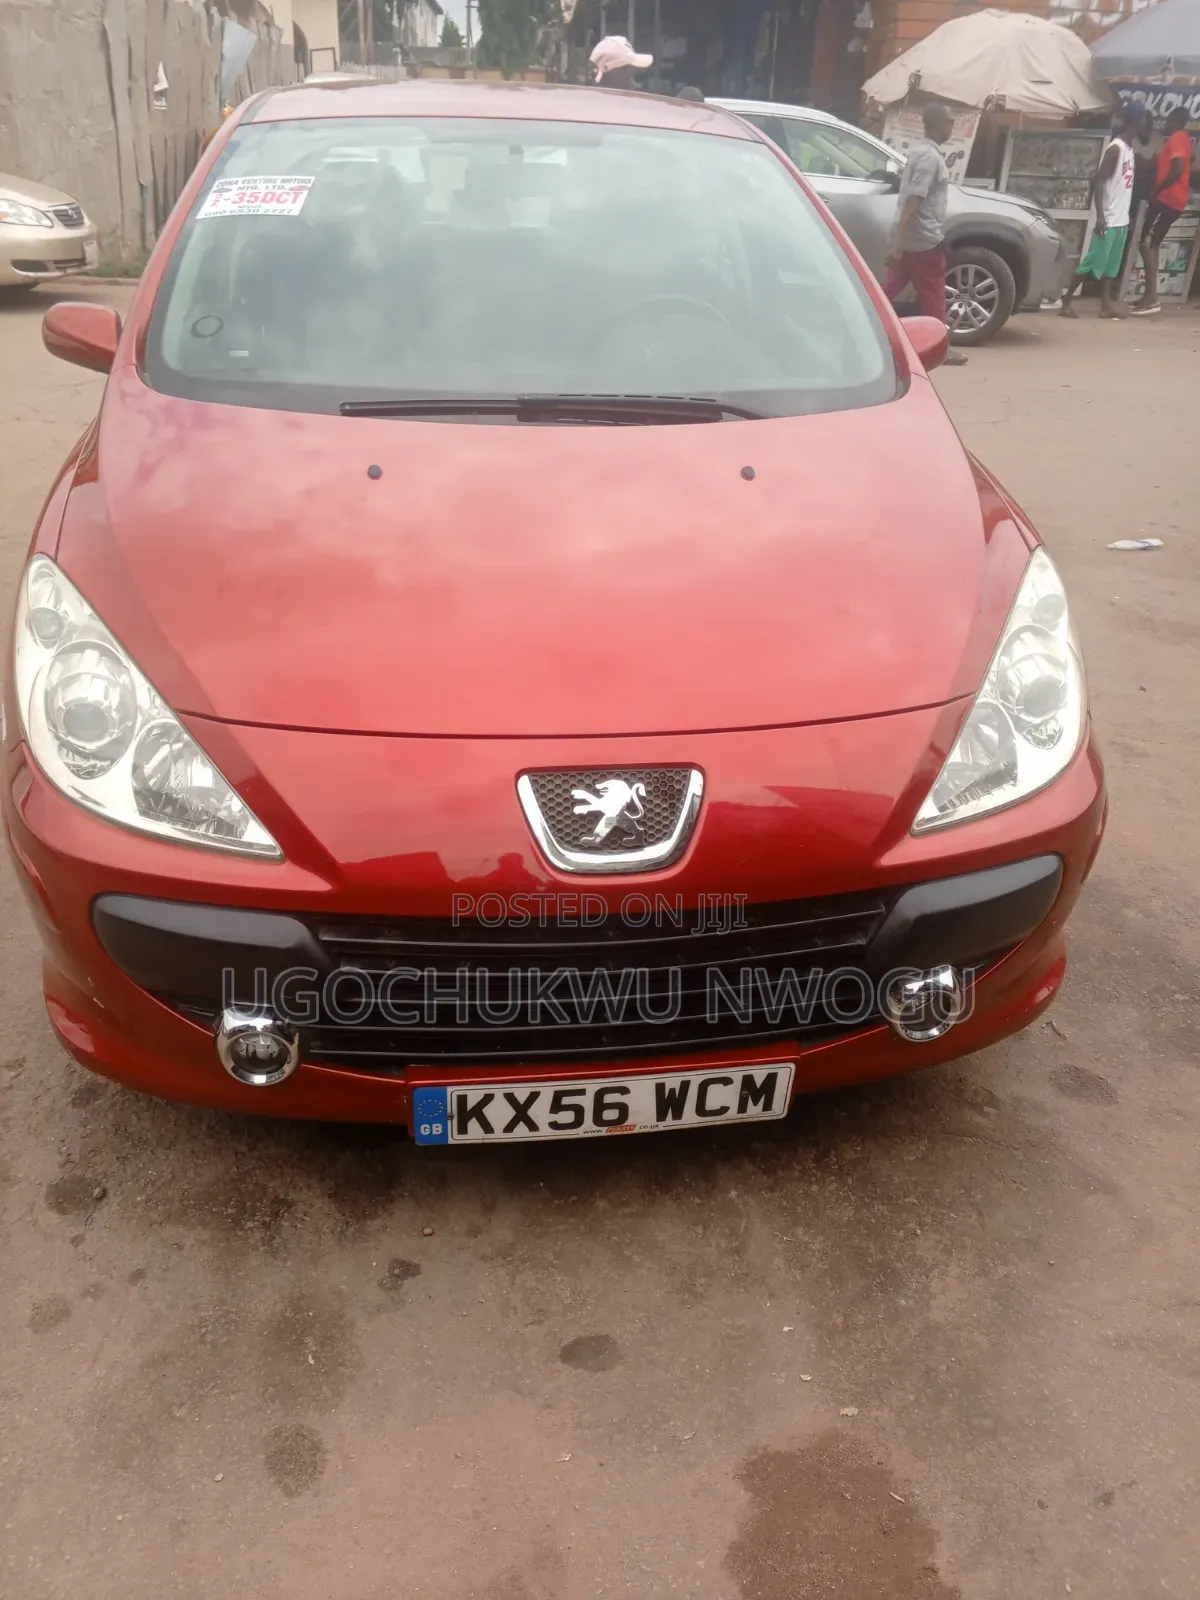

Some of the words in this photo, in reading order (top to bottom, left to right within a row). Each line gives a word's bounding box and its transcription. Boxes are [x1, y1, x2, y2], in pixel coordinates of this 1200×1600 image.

[456, 1085, 631, 1136] KX56
[654, 1071, 779, 1123] WCM
[419, 1123, 443, 1136] GB
